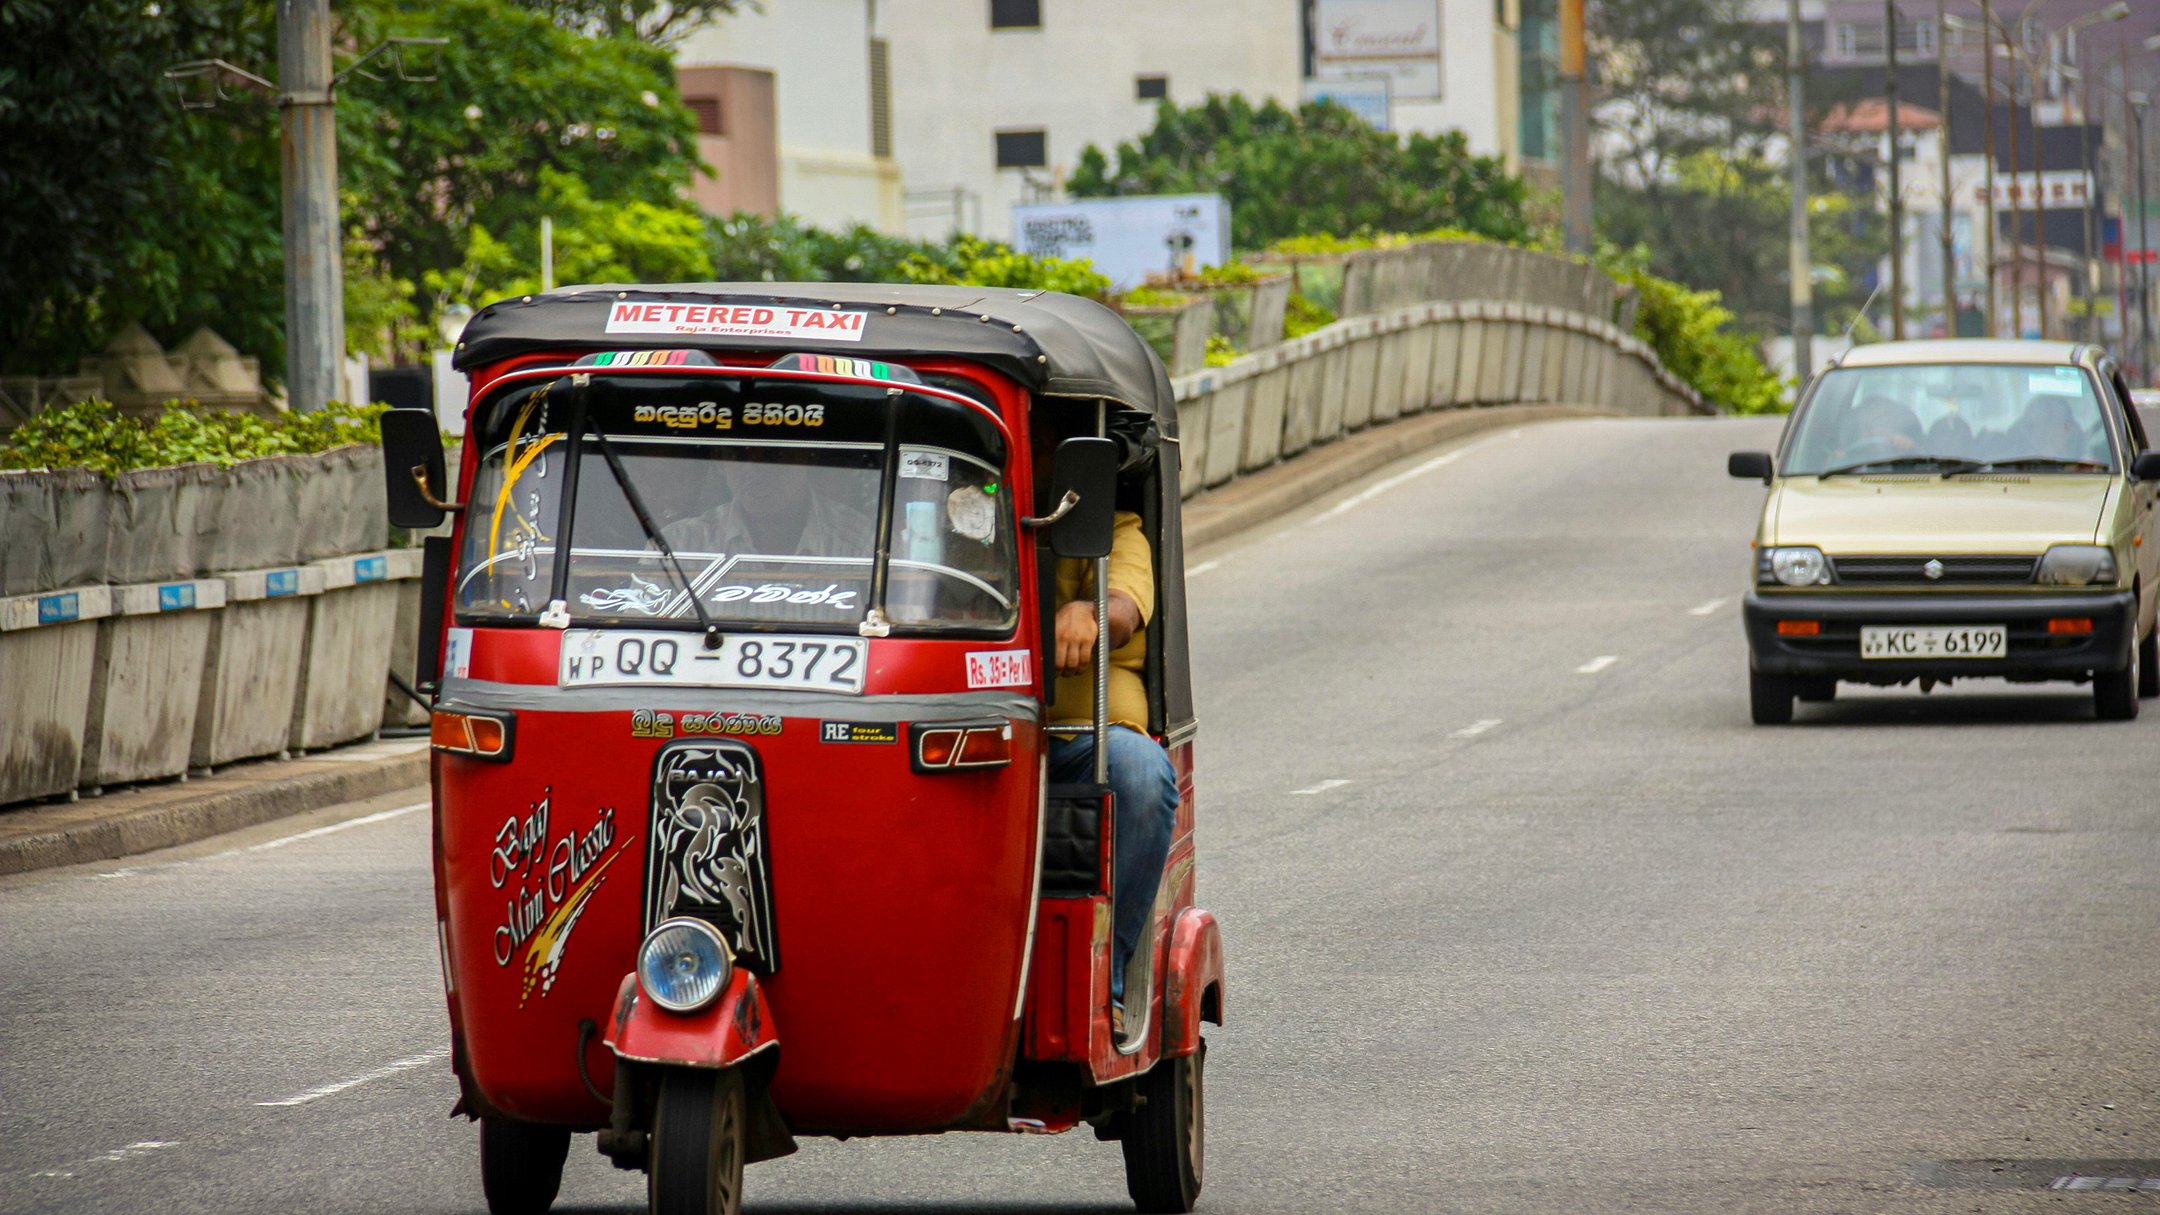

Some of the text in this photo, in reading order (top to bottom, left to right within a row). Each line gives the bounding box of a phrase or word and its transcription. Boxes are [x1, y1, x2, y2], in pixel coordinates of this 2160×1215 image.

[613, 305, 862, 330] METERED TAXI
[675, 325, 792, 335] Raja Enterprises
[1887, 632, 1917, 653] KC
[1944, 631, 2002, 653] 6199
[616, 637, 679, 676] QQ
[737, 640, 858, 686] 8372
[969, 656, 987, 685] Rs.
[631, 708, 674, 738] බුදු
[852, 726, 882, 734] four
[851, 734, 895, 742] stroke
[670, 768, 743, 783] BAJAJ
[490, 786, 551, 889] Bajaj
[494, 808, 614, 966] Mini Classic
